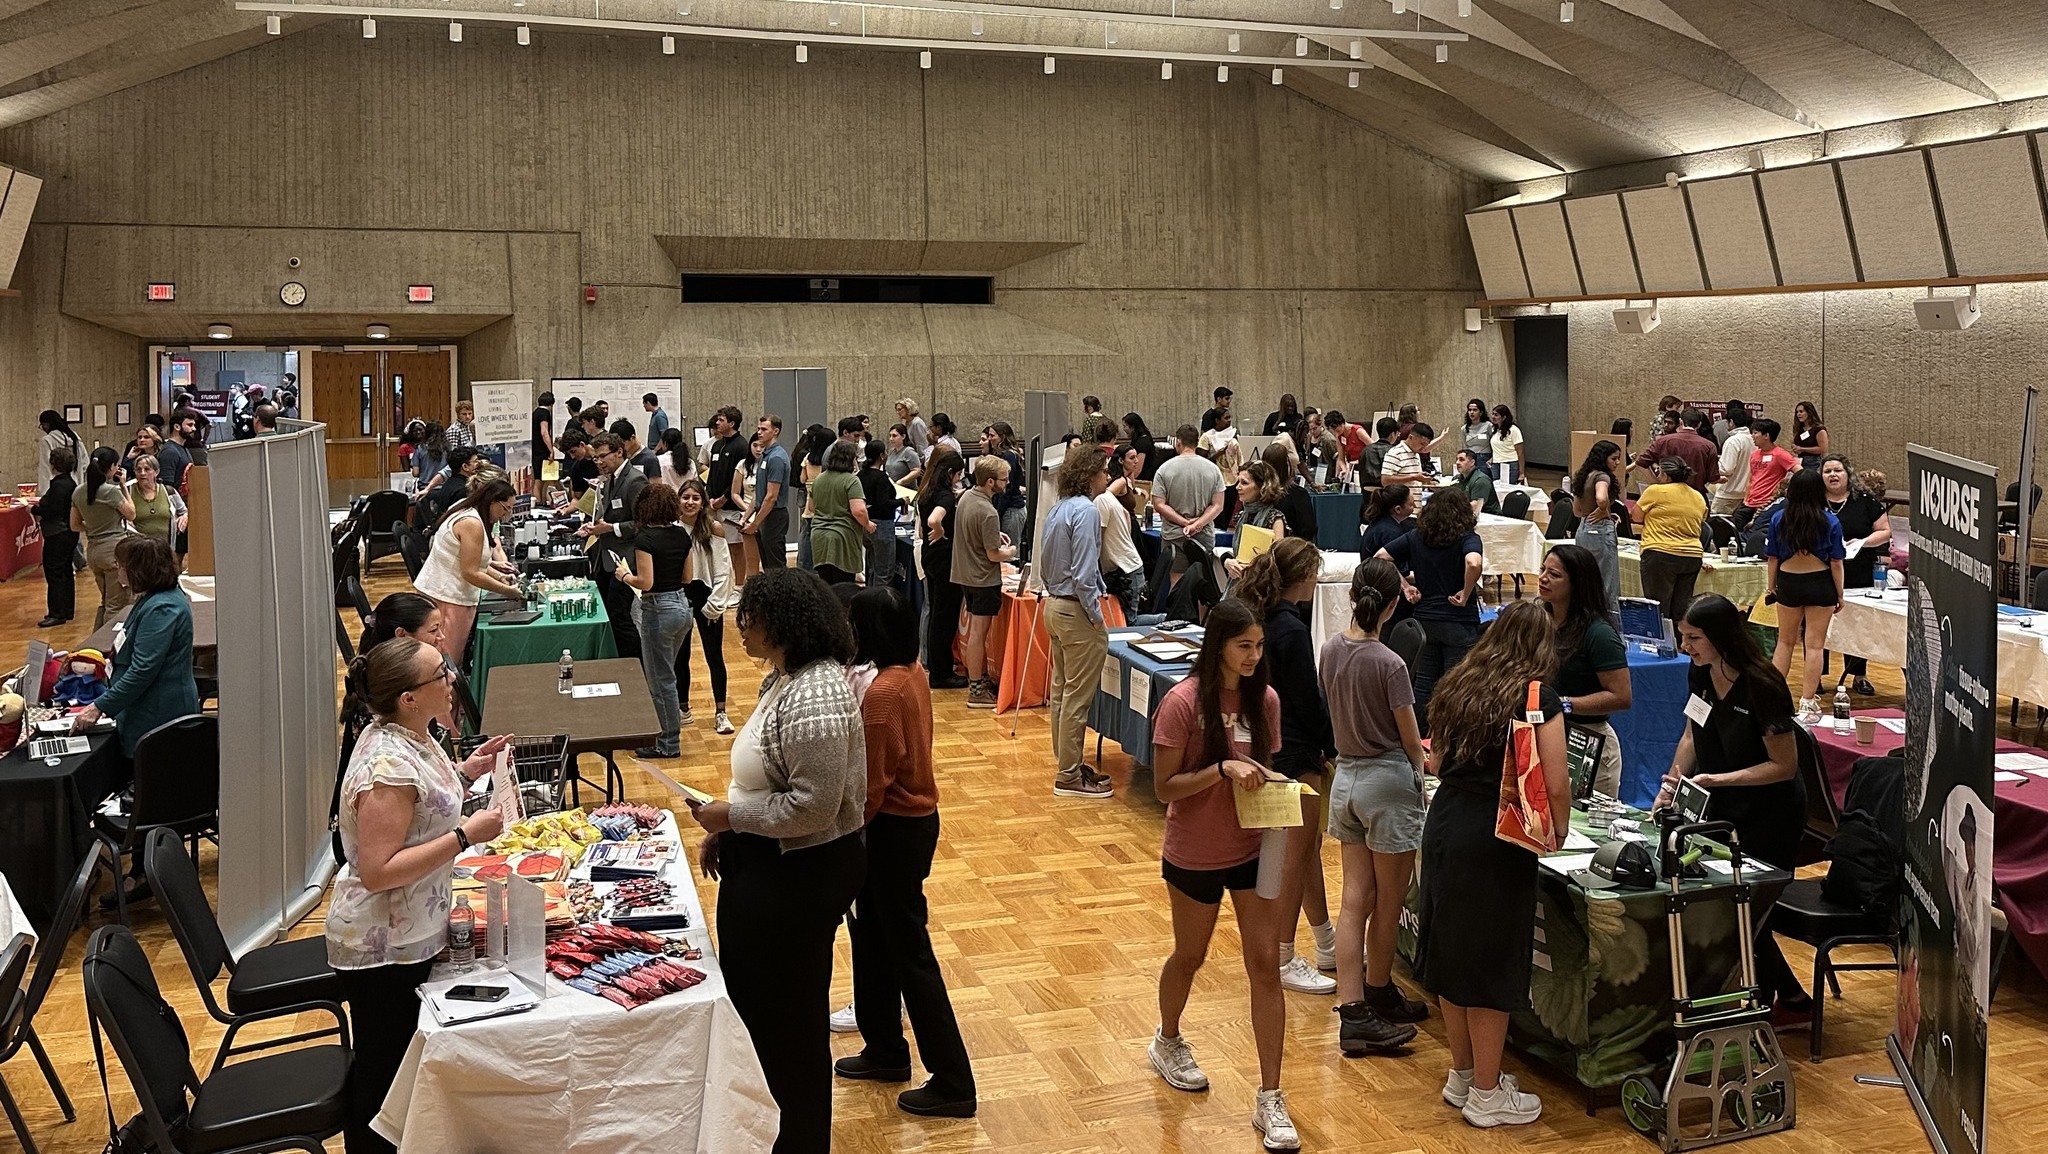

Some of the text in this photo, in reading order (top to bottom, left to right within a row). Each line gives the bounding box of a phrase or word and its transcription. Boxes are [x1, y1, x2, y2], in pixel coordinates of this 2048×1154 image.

[478, 412, 528, 423] LOVE WHERE YOU LIVE
[1921, 469, 1980, 540] NOURSE
